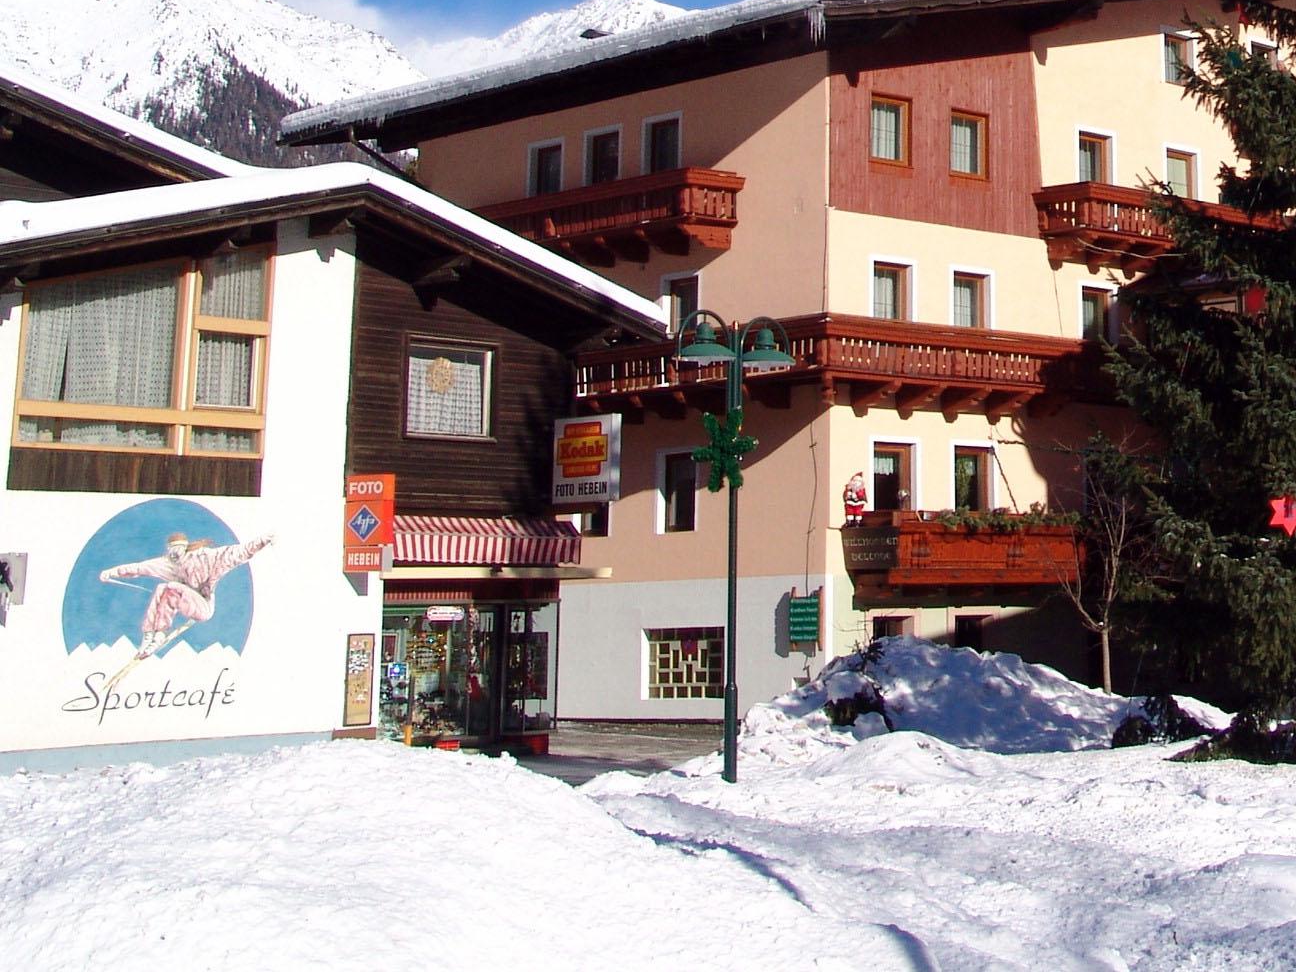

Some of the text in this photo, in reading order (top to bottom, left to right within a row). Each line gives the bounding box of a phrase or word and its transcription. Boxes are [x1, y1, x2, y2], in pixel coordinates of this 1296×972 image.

[559, 439, 605, 459] Kodak
[348, 481, 384, 496] FOTO
[555, 481, 608, 497] FOTO HEBEIN
[352, 513, 376, 535] Agfa
[347, 552, 380, 566] HEBEIN
[61, 667, 236, 726] Sportcafé
